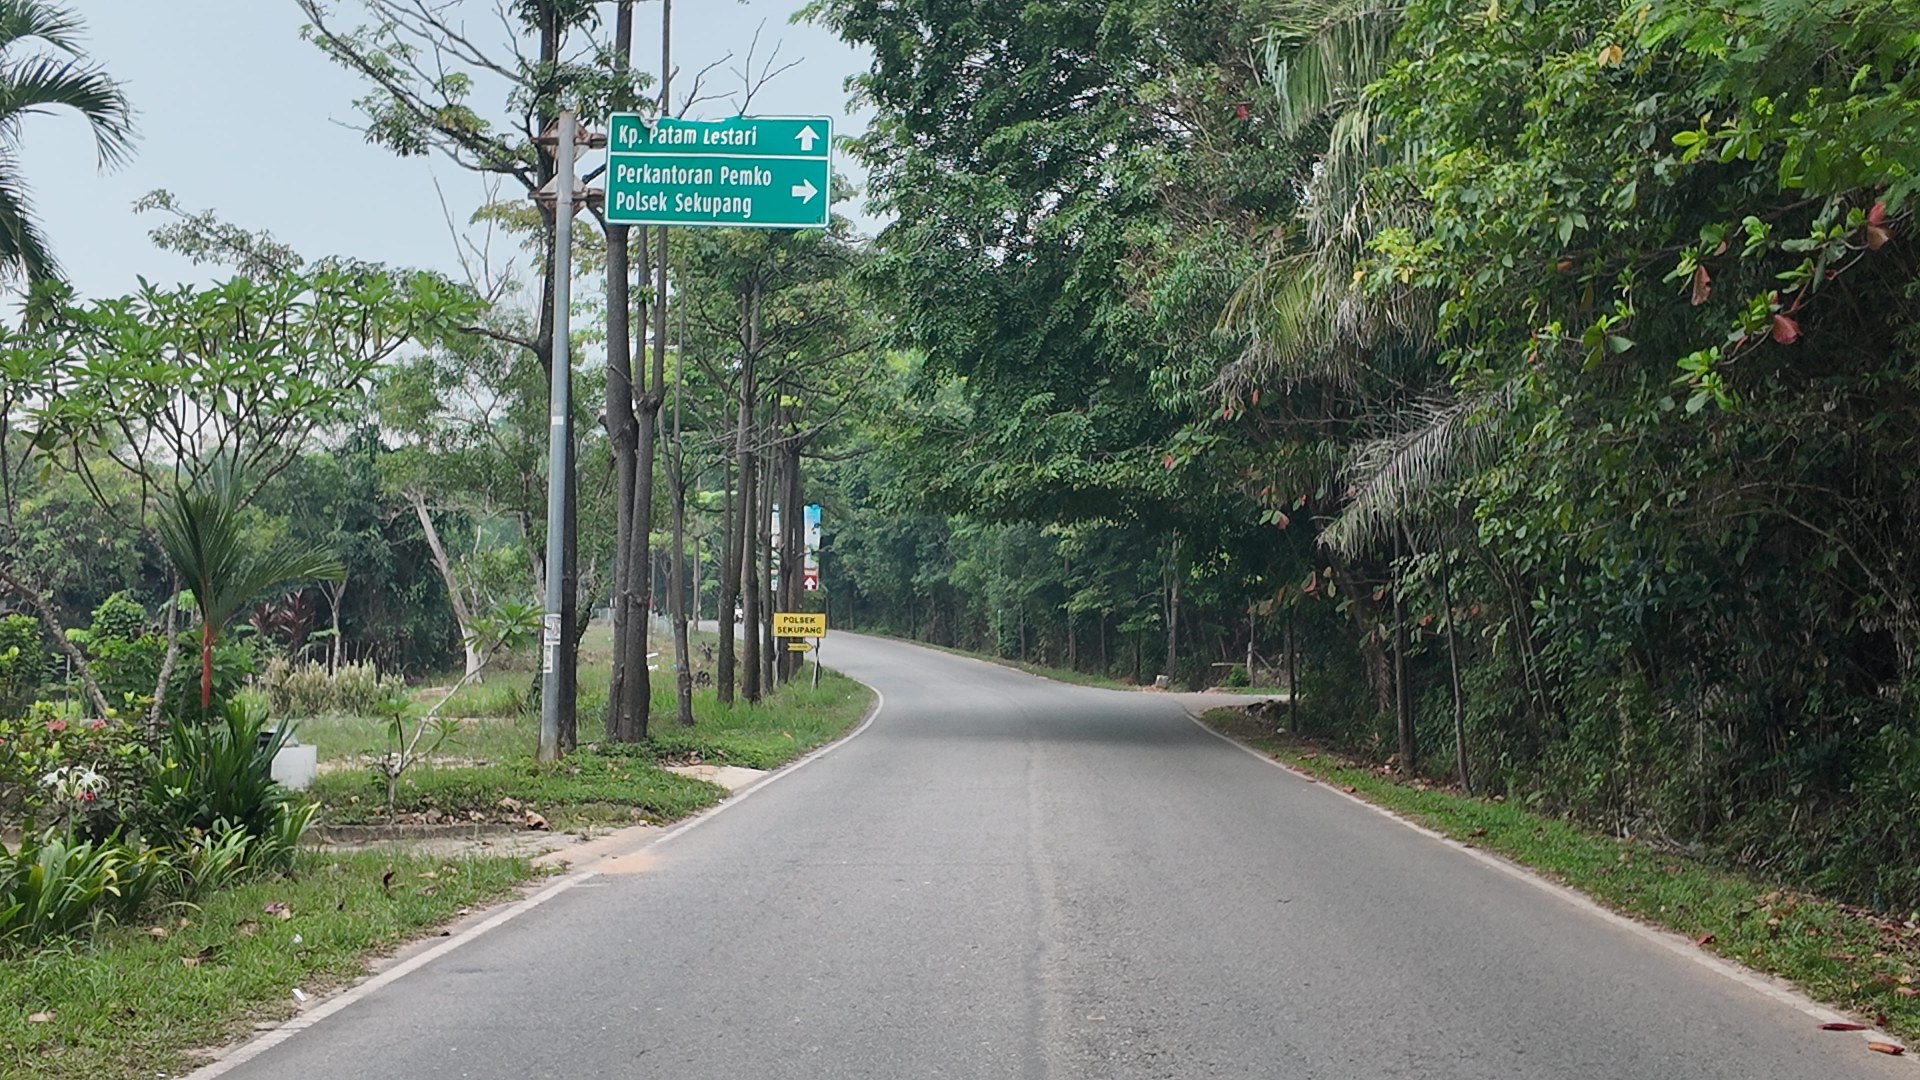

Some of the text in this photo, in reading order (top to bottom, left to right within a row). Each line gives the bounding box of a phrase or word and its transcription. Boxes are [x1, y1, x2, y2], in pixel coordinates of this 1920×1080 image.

[619, 125, 757, 148] Kp. Patam Lestari
[617, 164, 772, 186] Perkantoran Pemko
[616, 191, 751, 218] Polsek Sekupang
[777, 626, 822, 634] SEKUPANG
[783, 616, 816, 624] POLSEK
